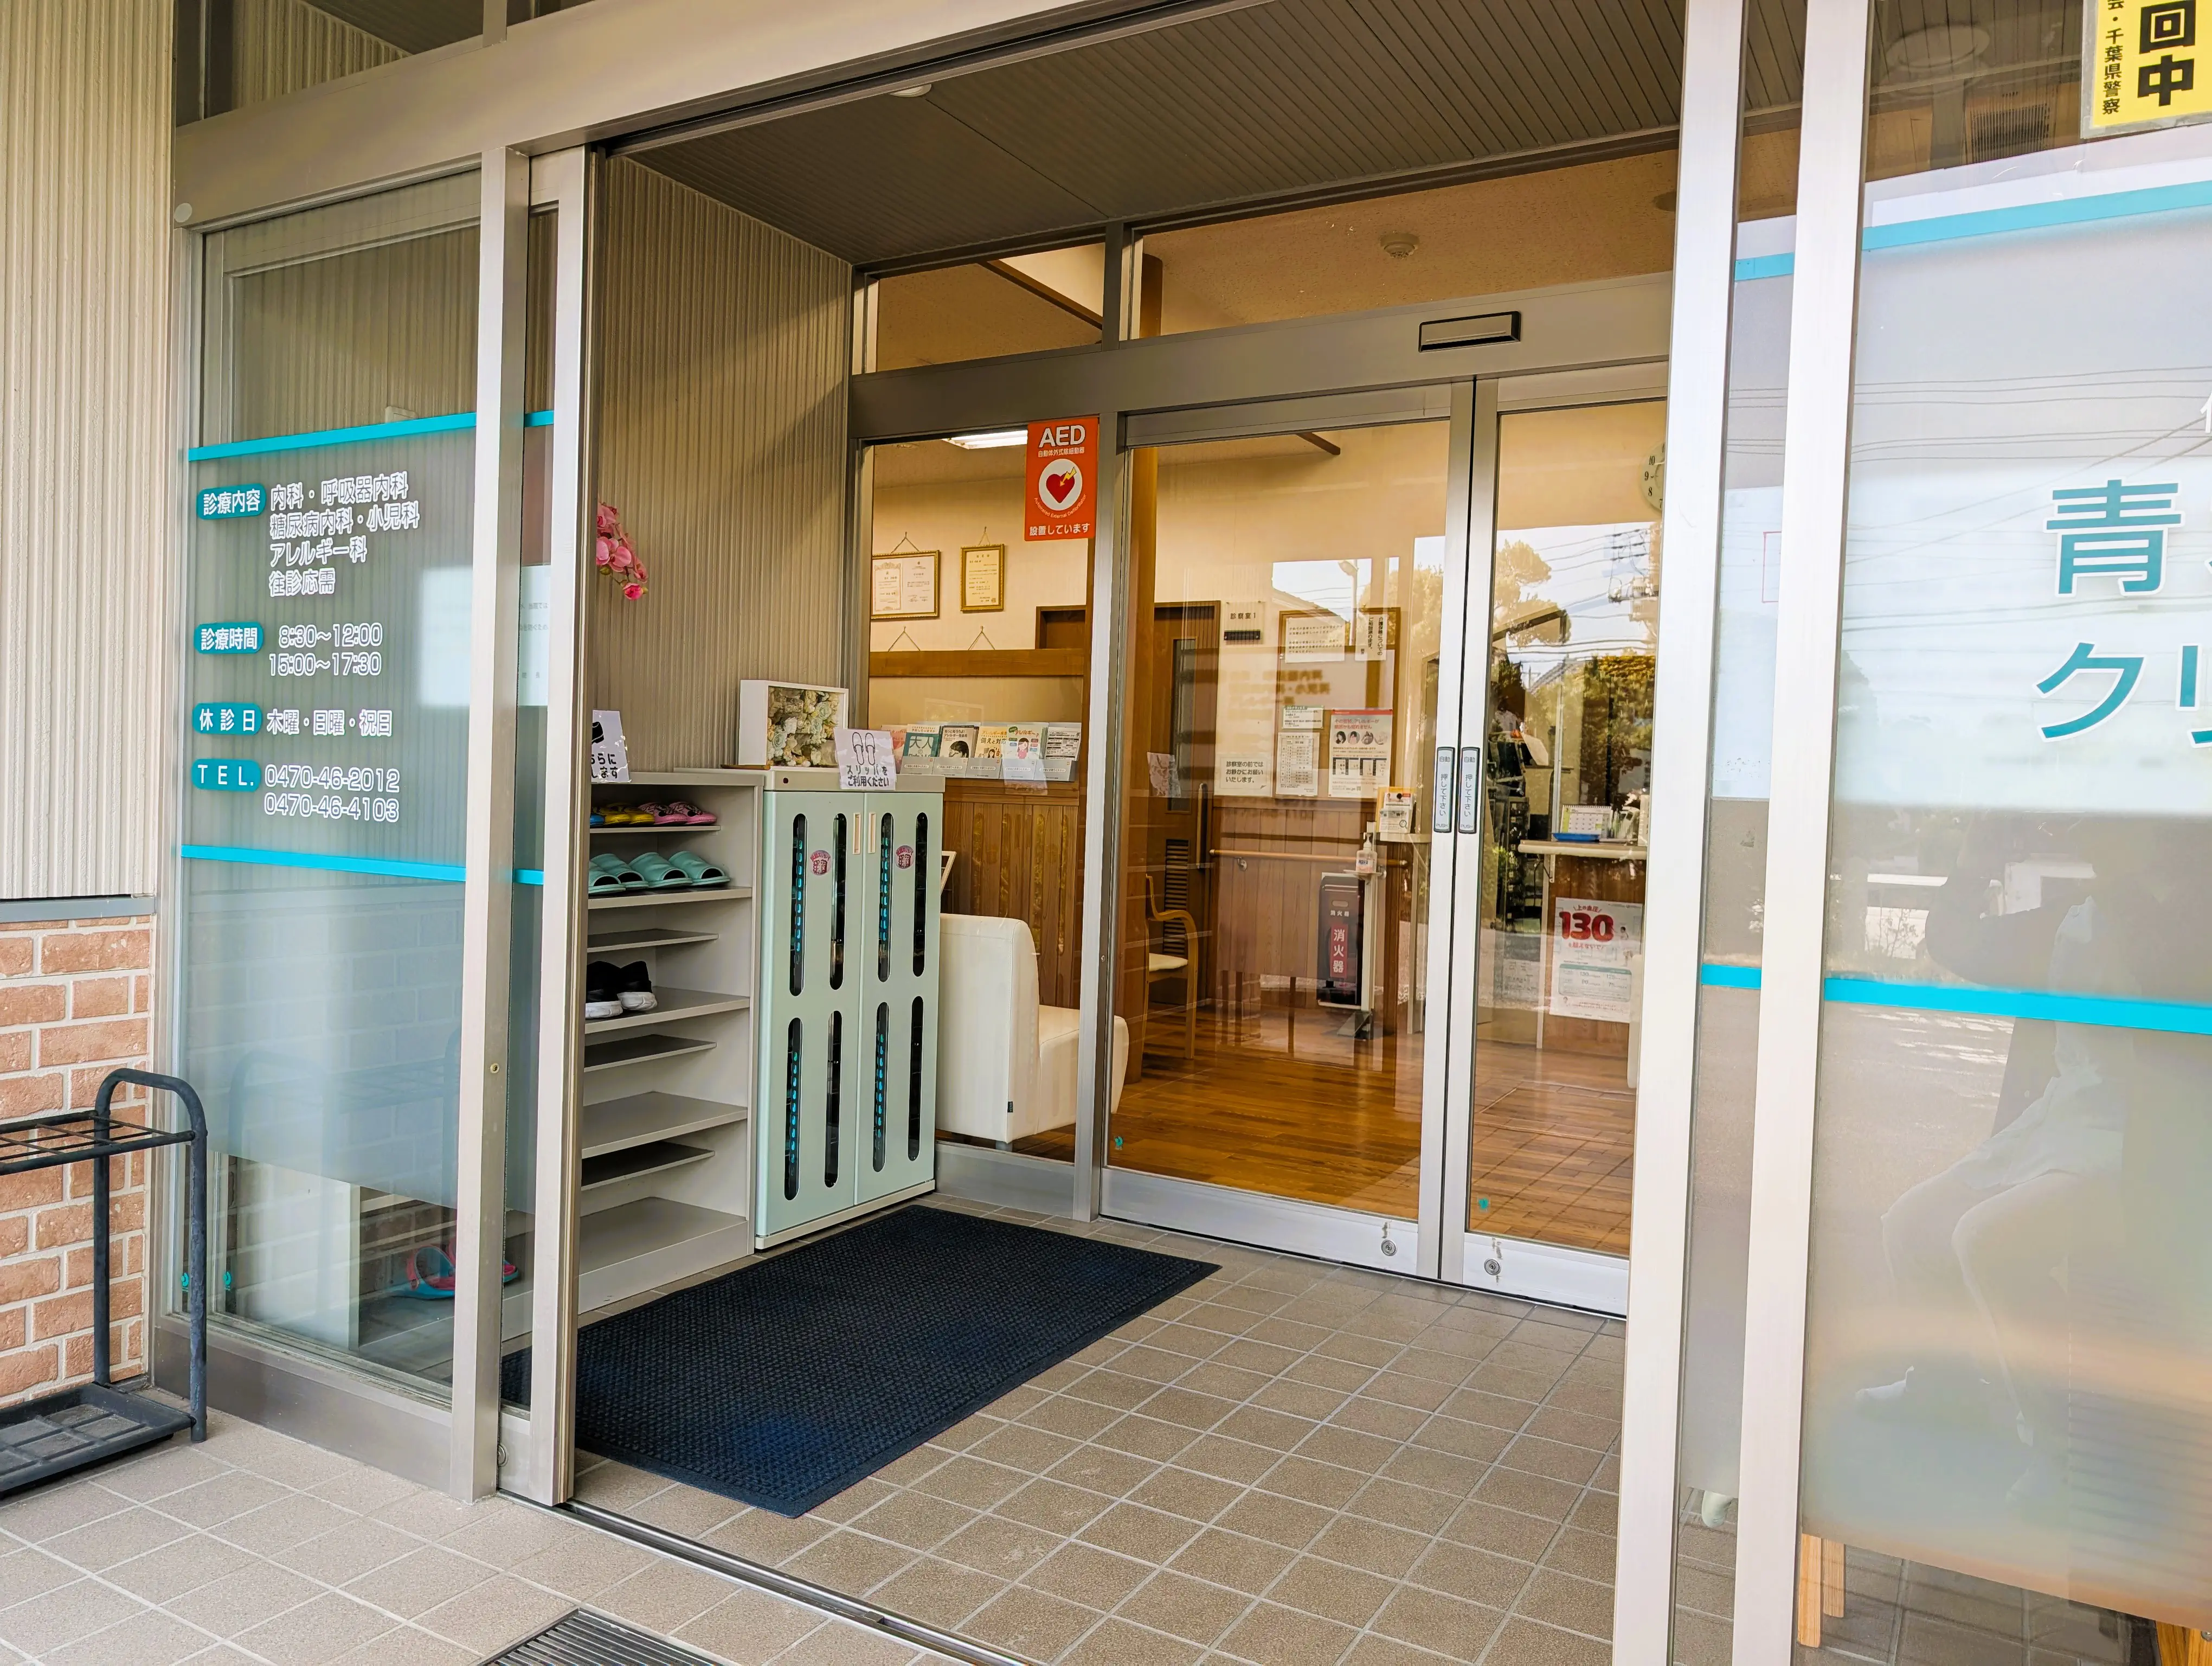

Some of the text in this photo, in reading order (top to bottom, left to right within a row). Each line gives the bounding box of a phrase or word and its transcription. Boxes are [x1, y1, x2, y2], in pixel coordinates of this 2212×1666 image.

[2138, 0, 2196, 107] 回中
[1038, 425, 1086, 448] AED
[1649, 456, 1655, 465] 10
[1644, 471, 1649, 481] 9
[203, 489, 261, 516] 診療内容
[270, 471, 409, 511] 内科・呼吸器内科
[1648, 486, 1652, 496] 8
[269, 500, 420, 539] 糖尿病内科・小児科
[1029, 522, 1090, 536] 設置しています
[2043, 477, 2212, 598] 青
[269, 535, 368, 568] アレルギー科
[269, 567, 336, 598] 往診応需
[201, 627, 258, 651] 診療時間
[199, 708, 256, 732] 休診日
[266, 708, 393, 736] 木曜・日曜・祝日
[909, 736, 933, 749] 大人
[265, 764, 401, 793] 0470-46-2012
[846, 764, 888, 776] スリッパを
[847, 774, 889, 787] ご利用ください
[263, 792, 400, 823] 0470-46-4103
[1559, 911, 1614, 943] 130
[1333, 928, 1345, 973] 消火器
